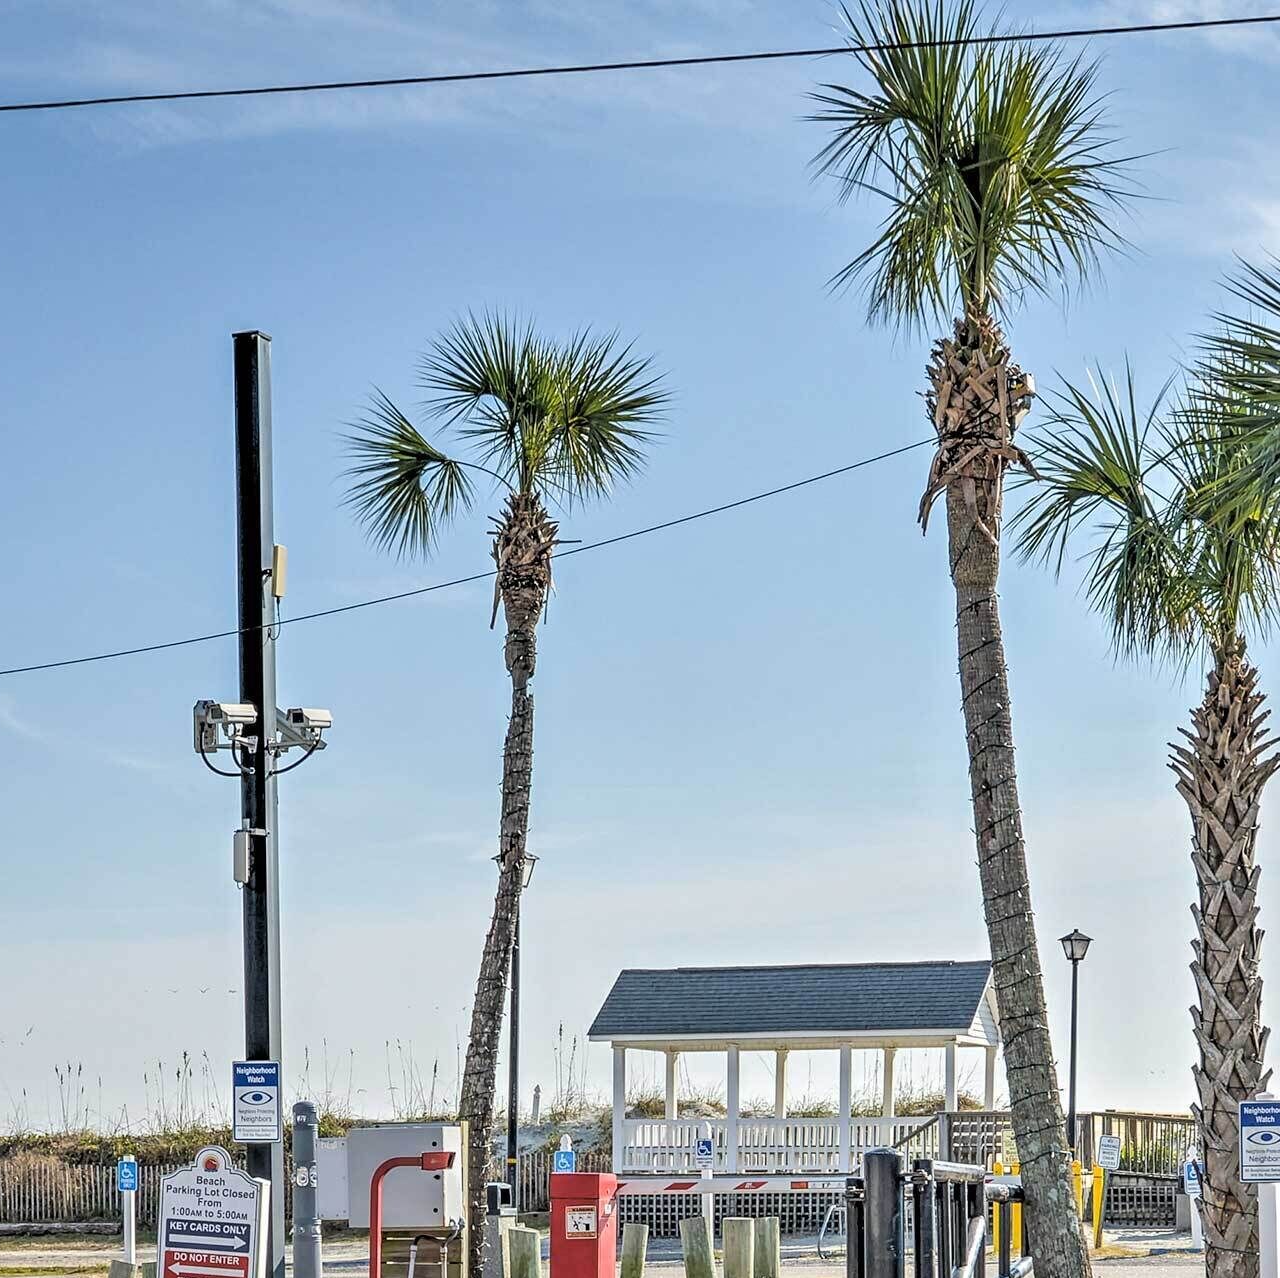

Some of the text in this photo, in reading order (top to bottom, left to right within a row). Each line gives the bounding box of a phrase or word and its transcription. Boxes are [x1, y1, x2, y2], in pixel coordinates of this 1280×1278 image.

[236, 1066, 276, 1076] Neighborhood
[247, 1075, 266, 1084] Watch
[240, 1115, 272, 1124] Neighbors
[1255, 1116, 1276, 1124] Watch
[196, 1176, 226, 1186] Beach
[166, 1184, 255, 1199] Parking Lot Closed
[197, 1197, 222, 1208] From
[171, 1206, 248, 1220] 1:00AM to 5:00AM
[169, 1221, 247, 1235] KEY CARDS ONLY
[173, 1252, 240, 1265] DO NOT ENTER
